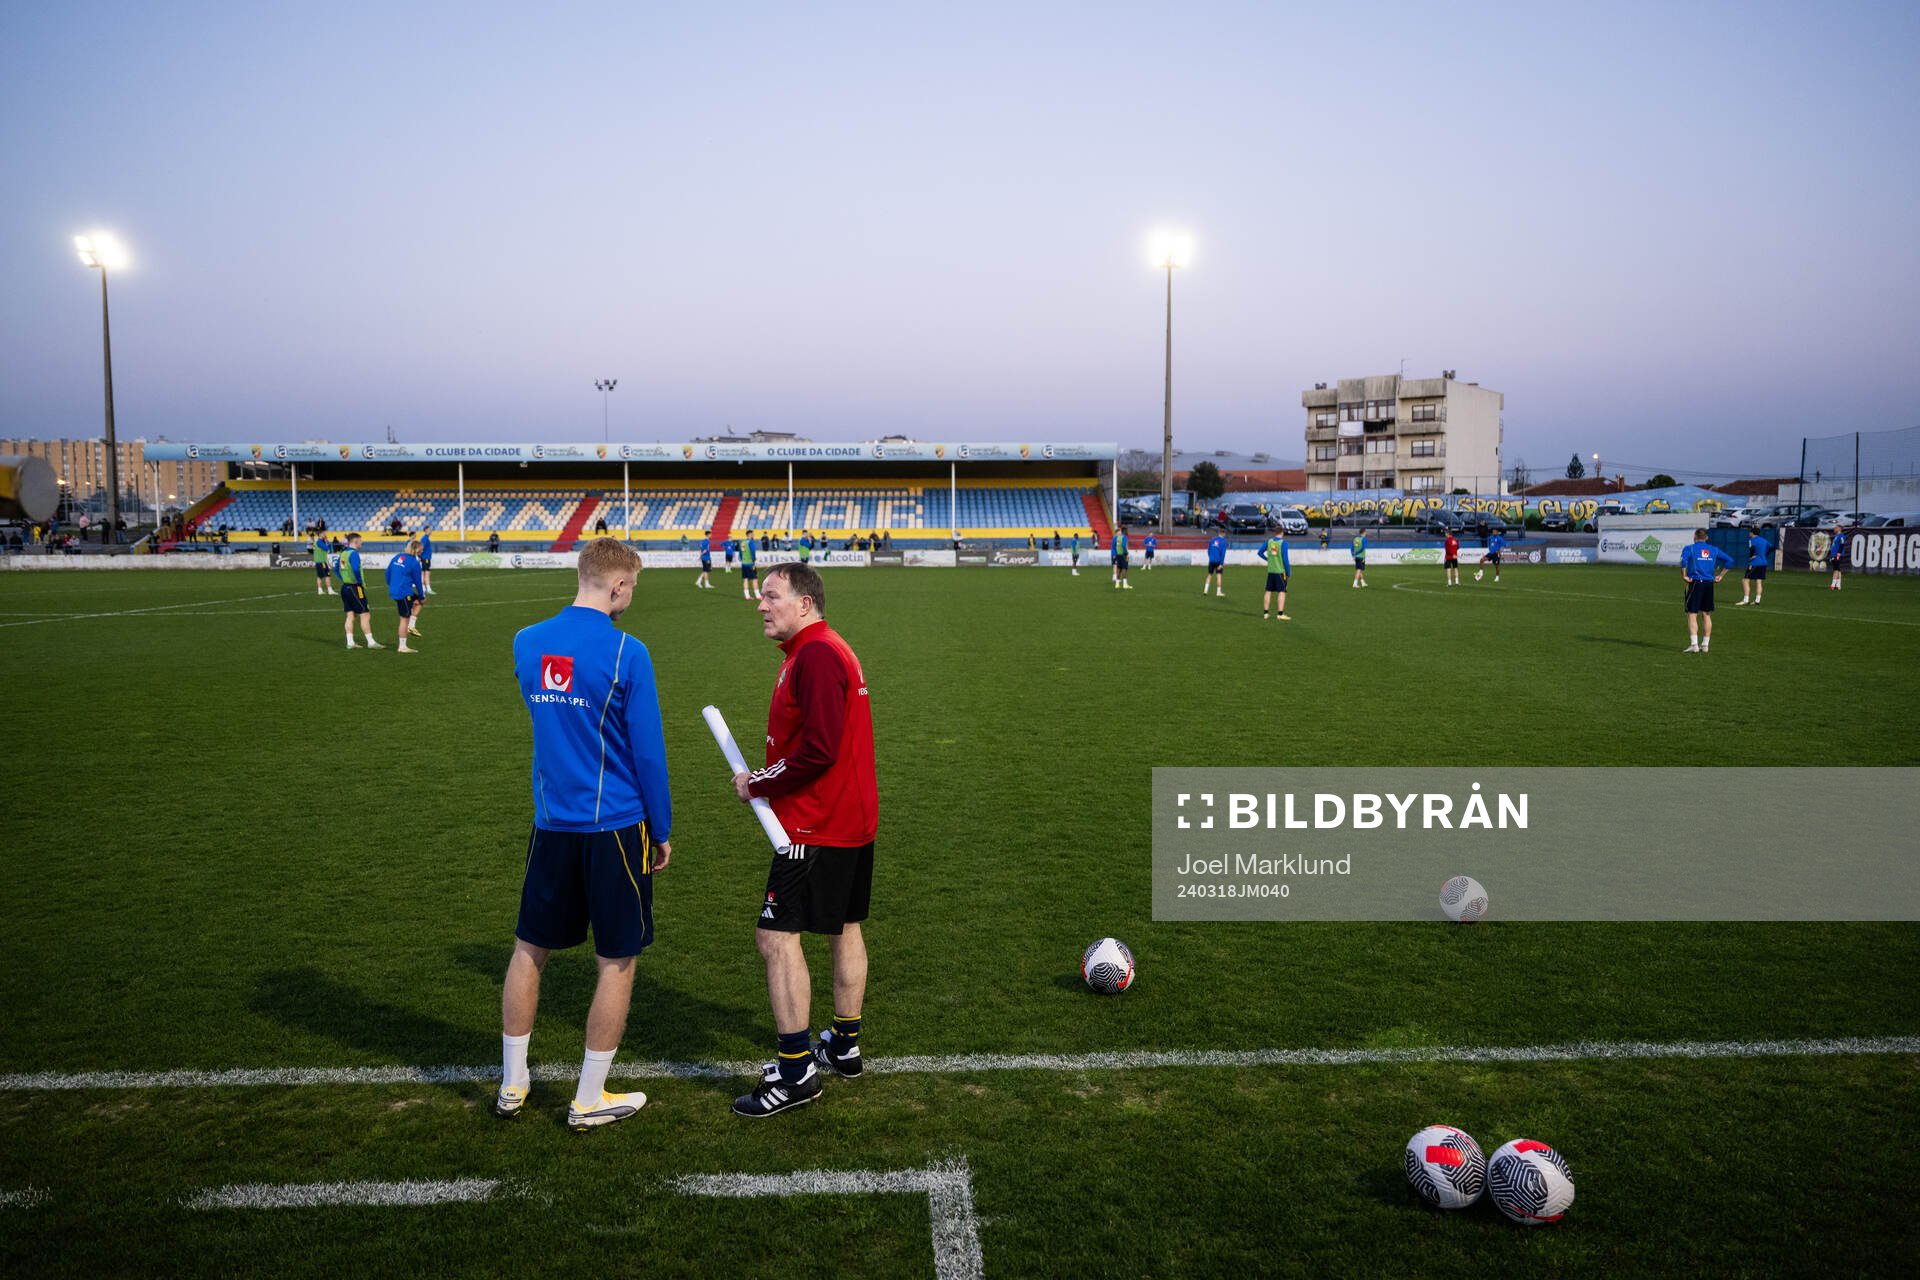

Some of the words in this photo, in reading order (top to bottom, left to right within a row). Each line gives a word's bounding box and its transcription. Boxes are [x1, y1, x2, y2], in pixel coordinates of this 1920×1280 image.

[426, 447, 434, 456] O
[436, 447, 467, 456] CLUBE
[469, 447, 485, 456] DA
[486, 447, 521, 456] CIDADE
[767, 447, 775, 456] O
[777, 447, 808, 456] CLUBE
[809, 447, 825, 456] DA
[826, 447, 861, 456] CIDADE
[1555, 549, 1582, 557] TOYO
[1851, 534, 1920, 568] OBRIG
[999, 556, 1035, 564] PLAYOFF
[568, 696, 591, 708] SPEL
